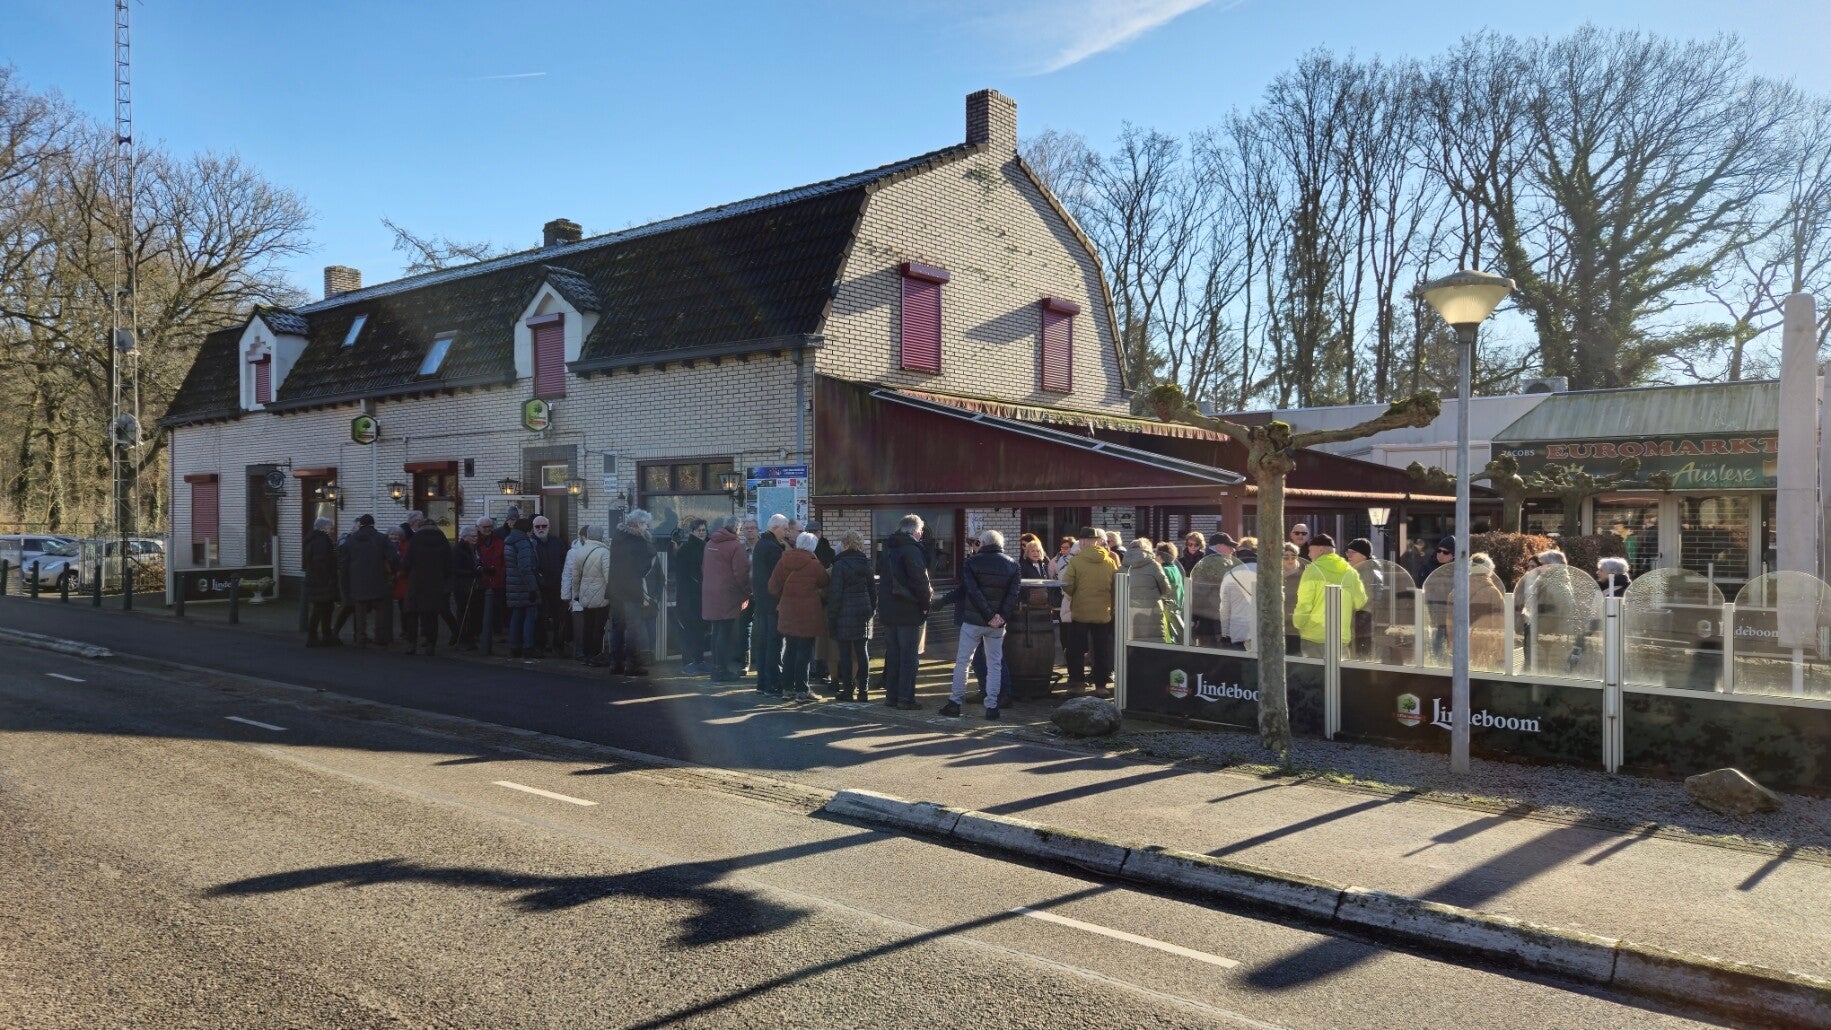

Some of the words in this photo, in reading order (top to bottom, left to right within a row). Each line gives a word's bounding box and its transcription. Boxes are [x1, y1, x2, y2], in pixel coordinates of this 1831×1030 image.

[1502, 449, 1536, 457] JACOBS
[1546, 437, 1778, 460] EUROMARKT
[1671, 461, 1758, 487] Auslese
[212, 578, 232, 591] Linde
[1194, 673, 1260, 702] Lindeboo
